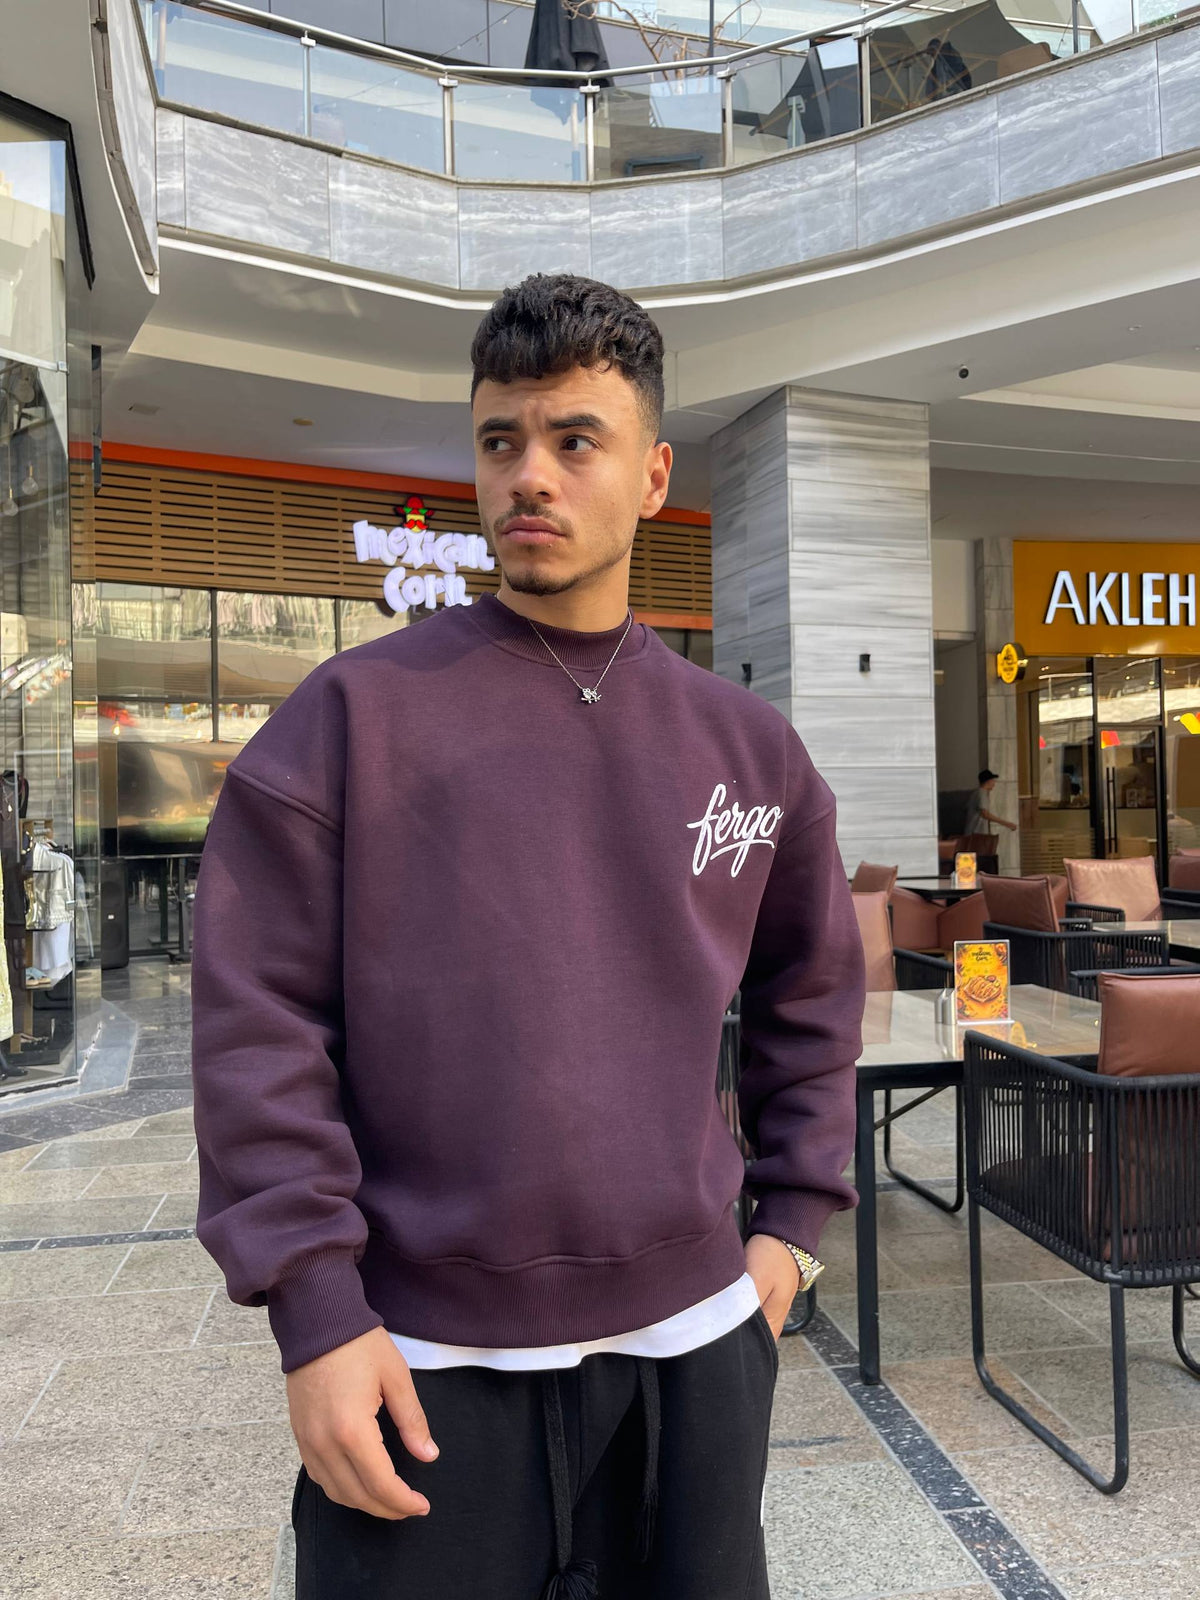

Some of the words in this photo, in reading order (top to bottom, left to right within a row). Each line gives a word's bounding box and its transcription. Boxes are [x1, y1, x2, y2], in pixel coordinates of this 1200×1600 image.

[383, 566, 473, 613] Corn
[1044, 570, 1196, 626] AKLEH
[686, 783, 785, 878] fergo
